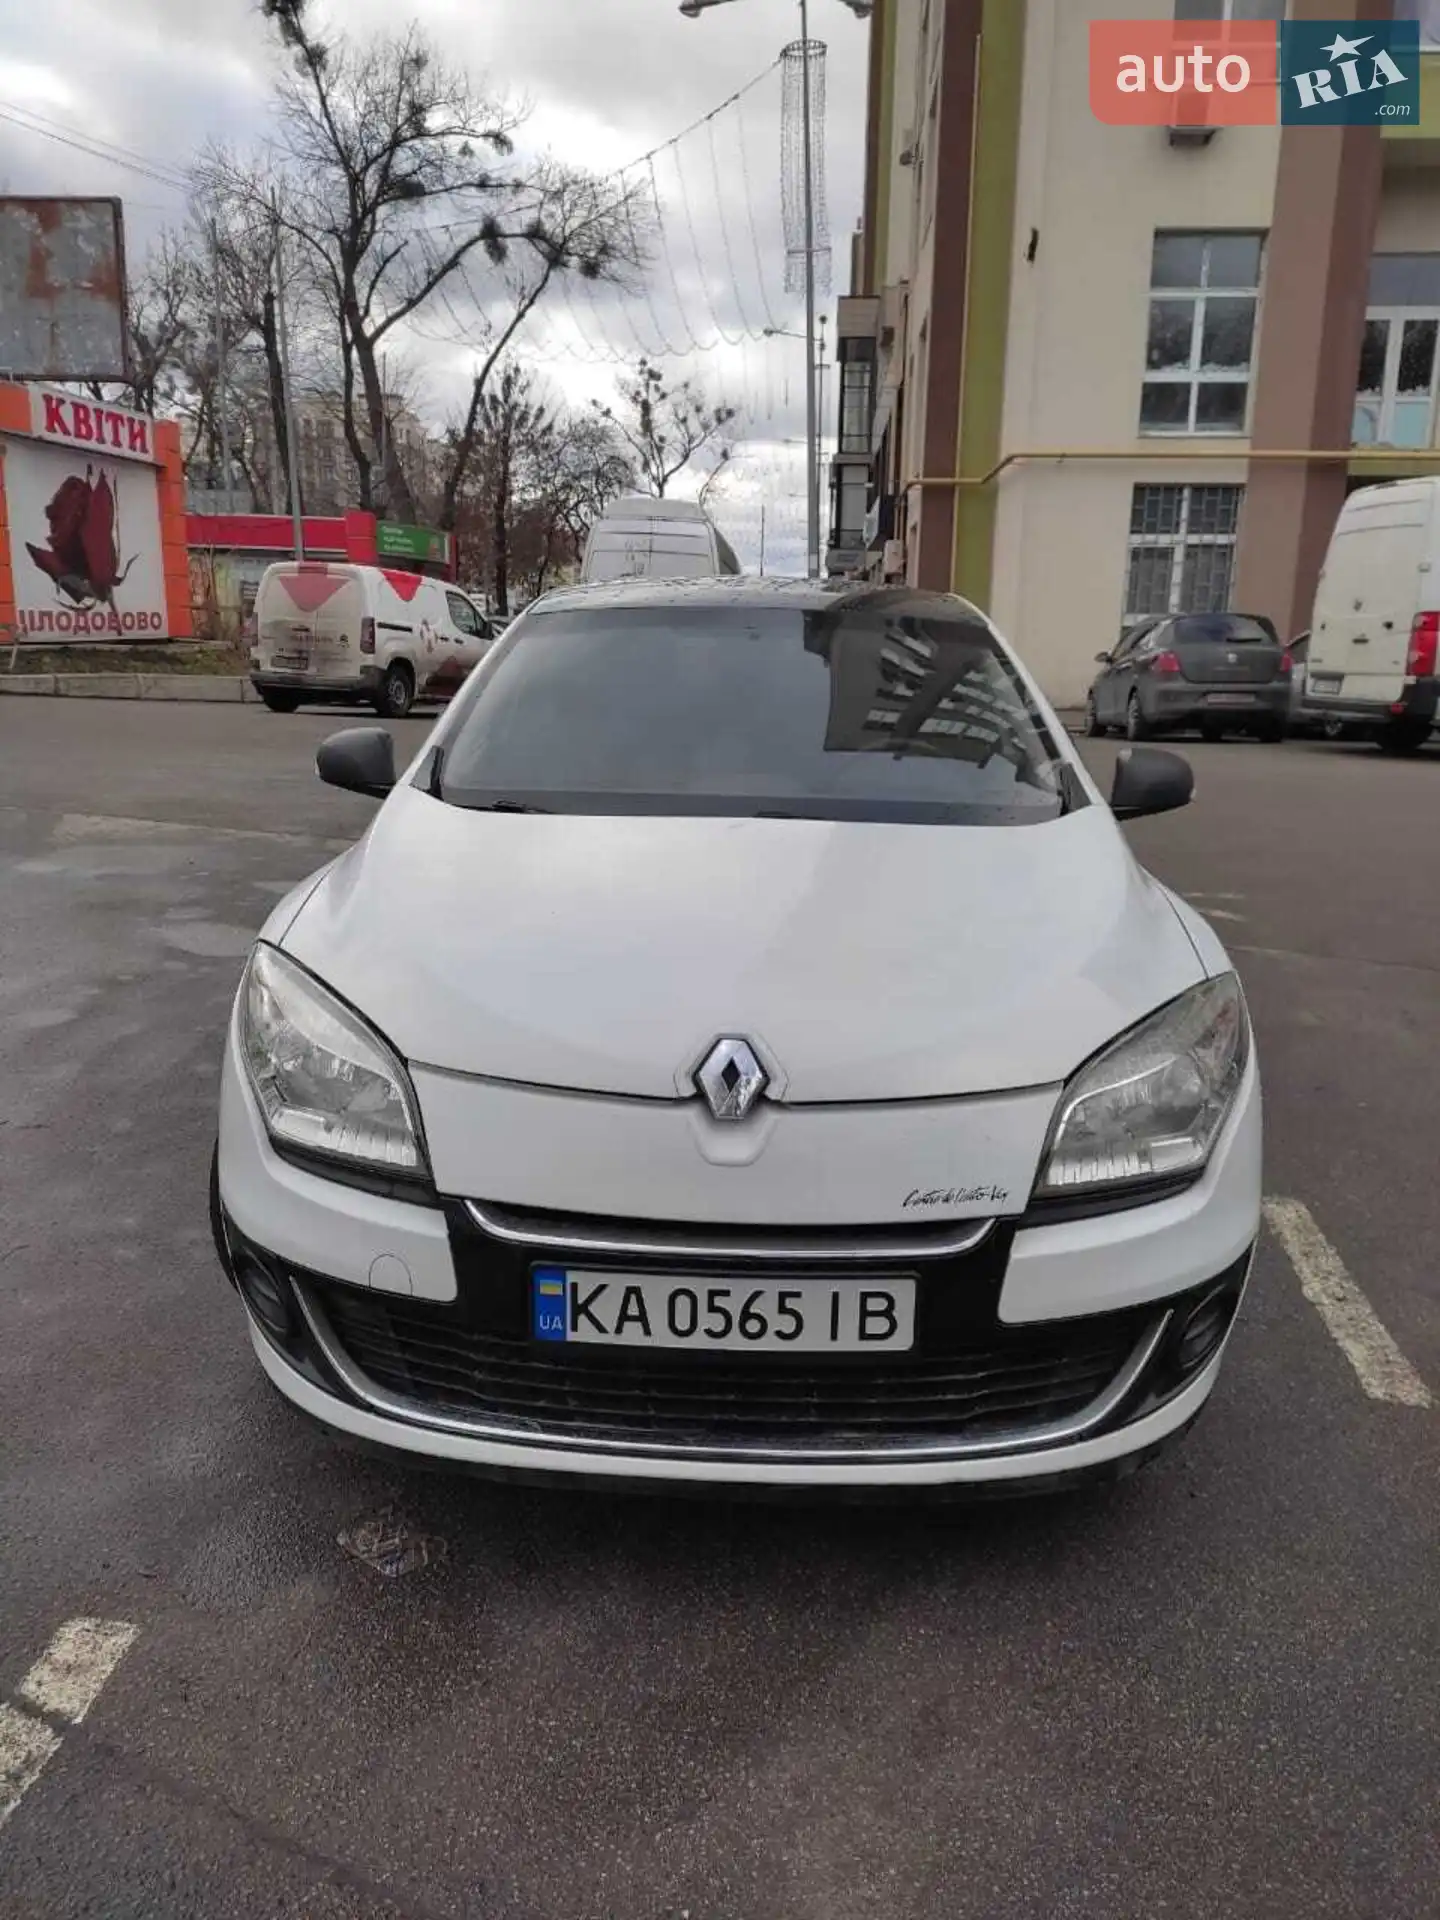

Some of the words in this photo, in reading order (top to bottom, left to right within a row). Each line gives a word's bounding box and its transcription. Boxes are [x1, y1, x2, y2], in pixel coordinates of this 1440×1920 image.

[42, 393, 149, 453] КВІТИ
[539, 1315, 563, 1331] UA
[569, 1281, 652, 1338] KA
[666, 1287, 805, 1342] 0565
[830, 1290, 899, 1342] IB
